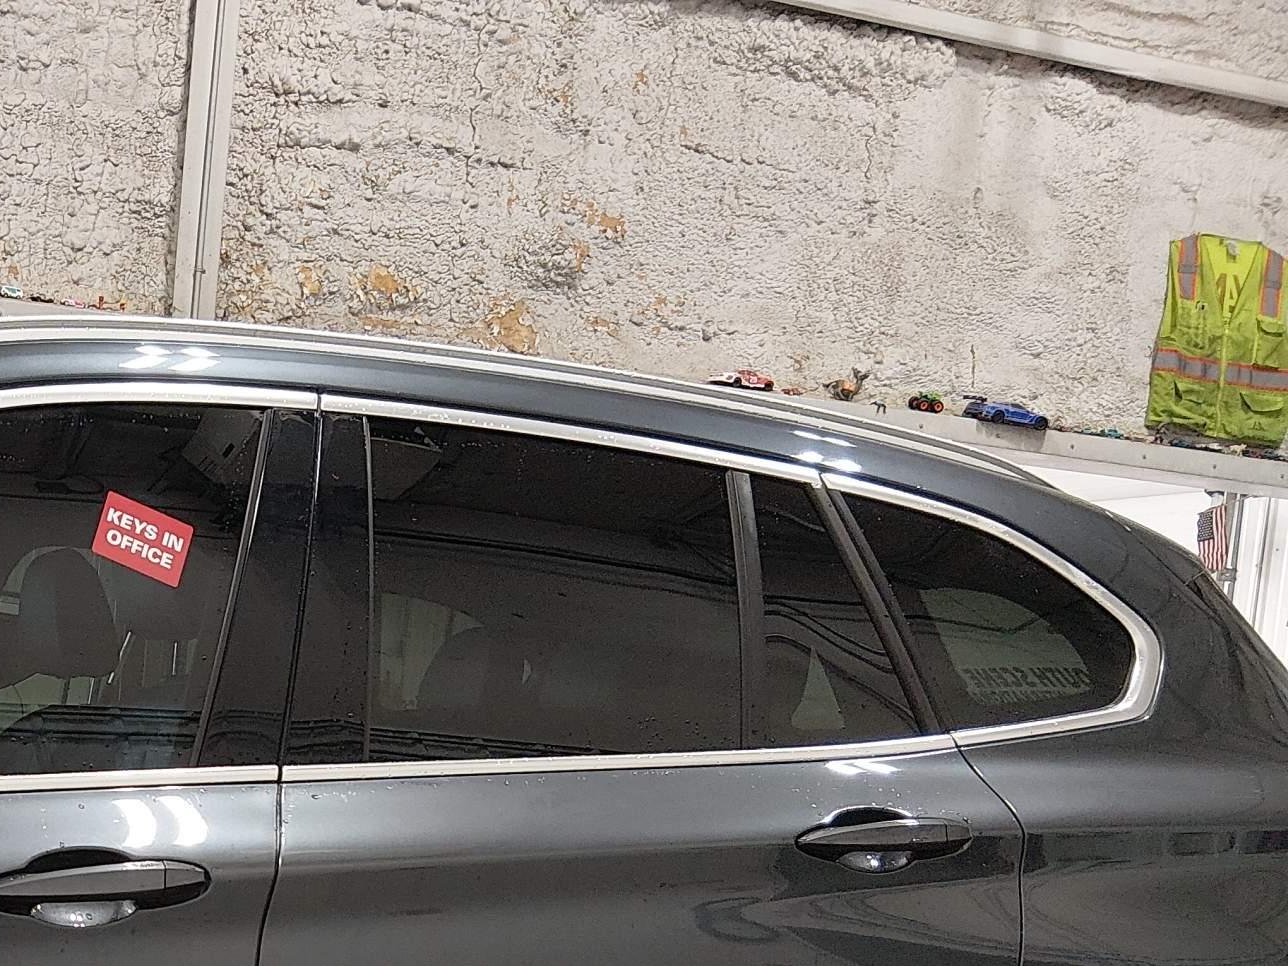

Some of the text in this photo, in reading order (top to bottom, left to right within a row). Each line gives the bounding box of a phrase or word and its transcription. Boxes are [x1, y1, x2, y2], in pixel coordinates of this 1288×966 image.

[106, 529, 174, 569] OFFICE
[107, 507, 184, 552] KEYS IN
